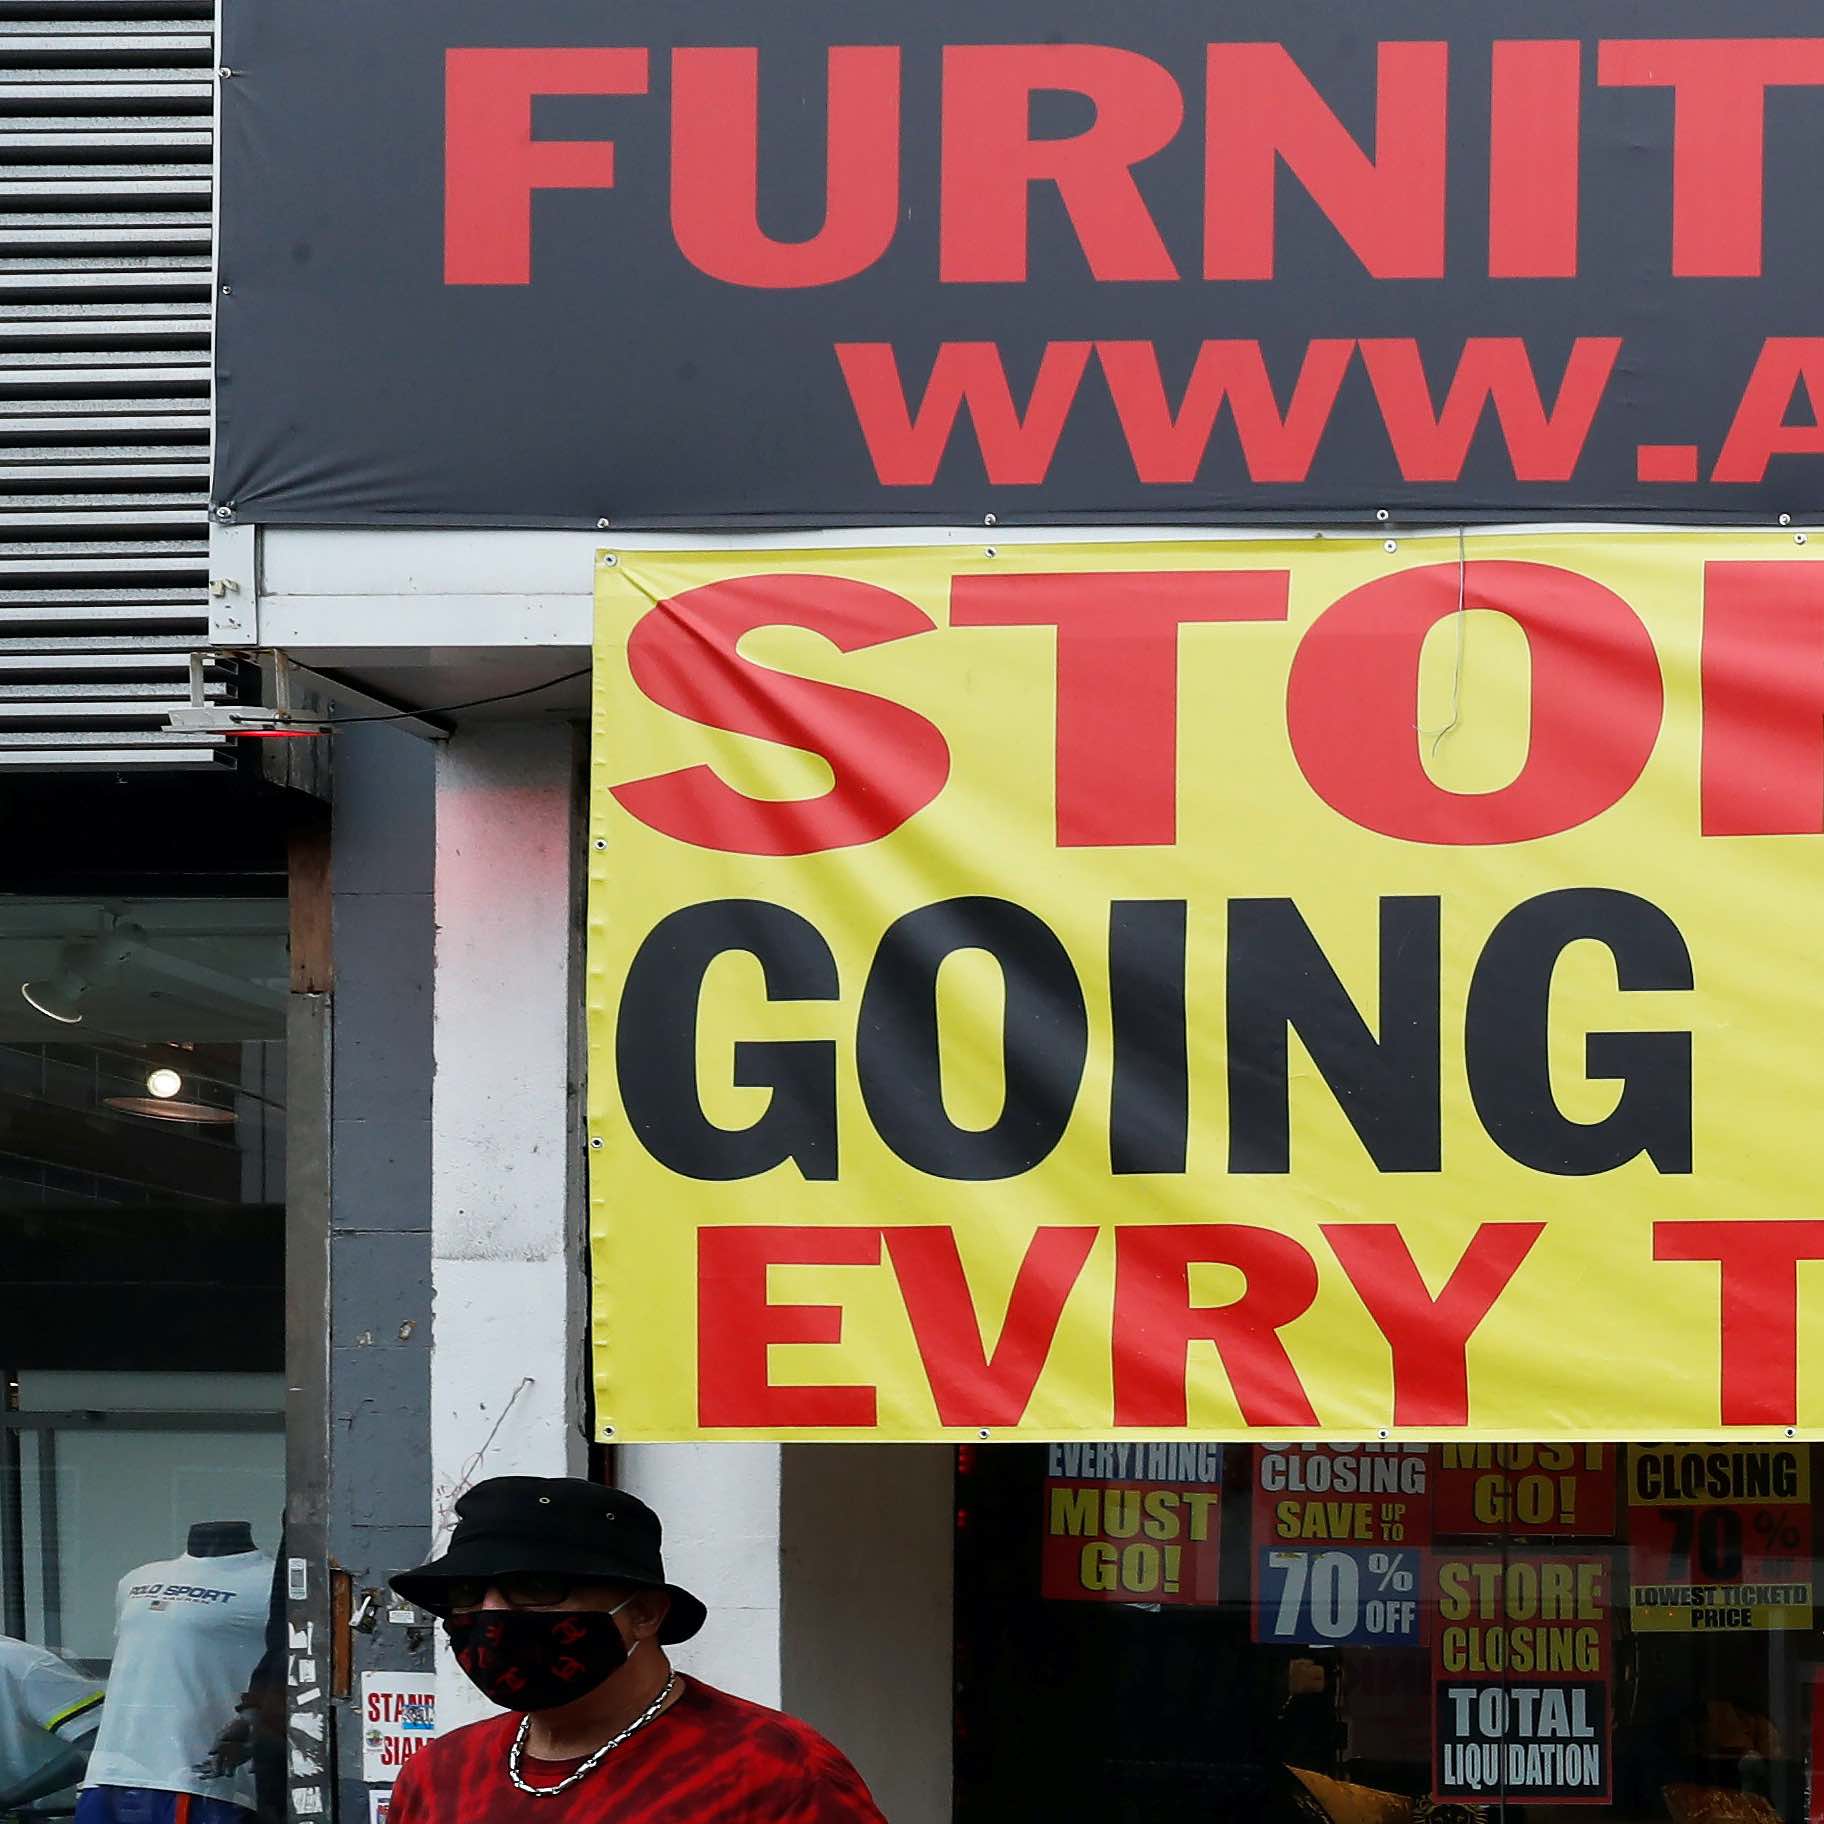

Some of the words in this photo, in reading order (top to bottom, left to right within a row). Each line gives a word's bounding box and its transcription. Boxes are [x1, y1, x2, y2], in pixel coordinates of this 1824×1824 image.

[615, 887, 1697, 1183] GOING
[697, 1221, 1547, 1430] EVRY
[1048, 1443, 1217, 1483] EVERYTHING
[1260, 1456, 1426, 1495] CLOSING
[1635, 1453, 1798, 1501] CLOSING
[1049, 1487, 1218, 1542] MUST
[1276, 1501, 1373, 1541] SAVE
[1381, 1503, 1406, 1521] UP
[1473, 1474, 1577, 1525] GO!
[1381, 1522, 1405, 1542] TO
[1080, 1542, 1182, 1594] GO!
[163, 1585, 237, 1604] SPORT
[1438, 1562, 1604, 1623] STORE
[1634, 1584, 1716, 1606] LOWEST
[1365, 1599, 1416, 1635] OFF
[1690, 1606, 1753, 1629] PRICE
[1442, 1626, 1600, 1673] CLOSING
[1448, 1687, 1595, 1738] TOTAL
[381, 1736, 435, 1766] SIA
[1443, 1743, 1600, 1790] LIQUIDATION
